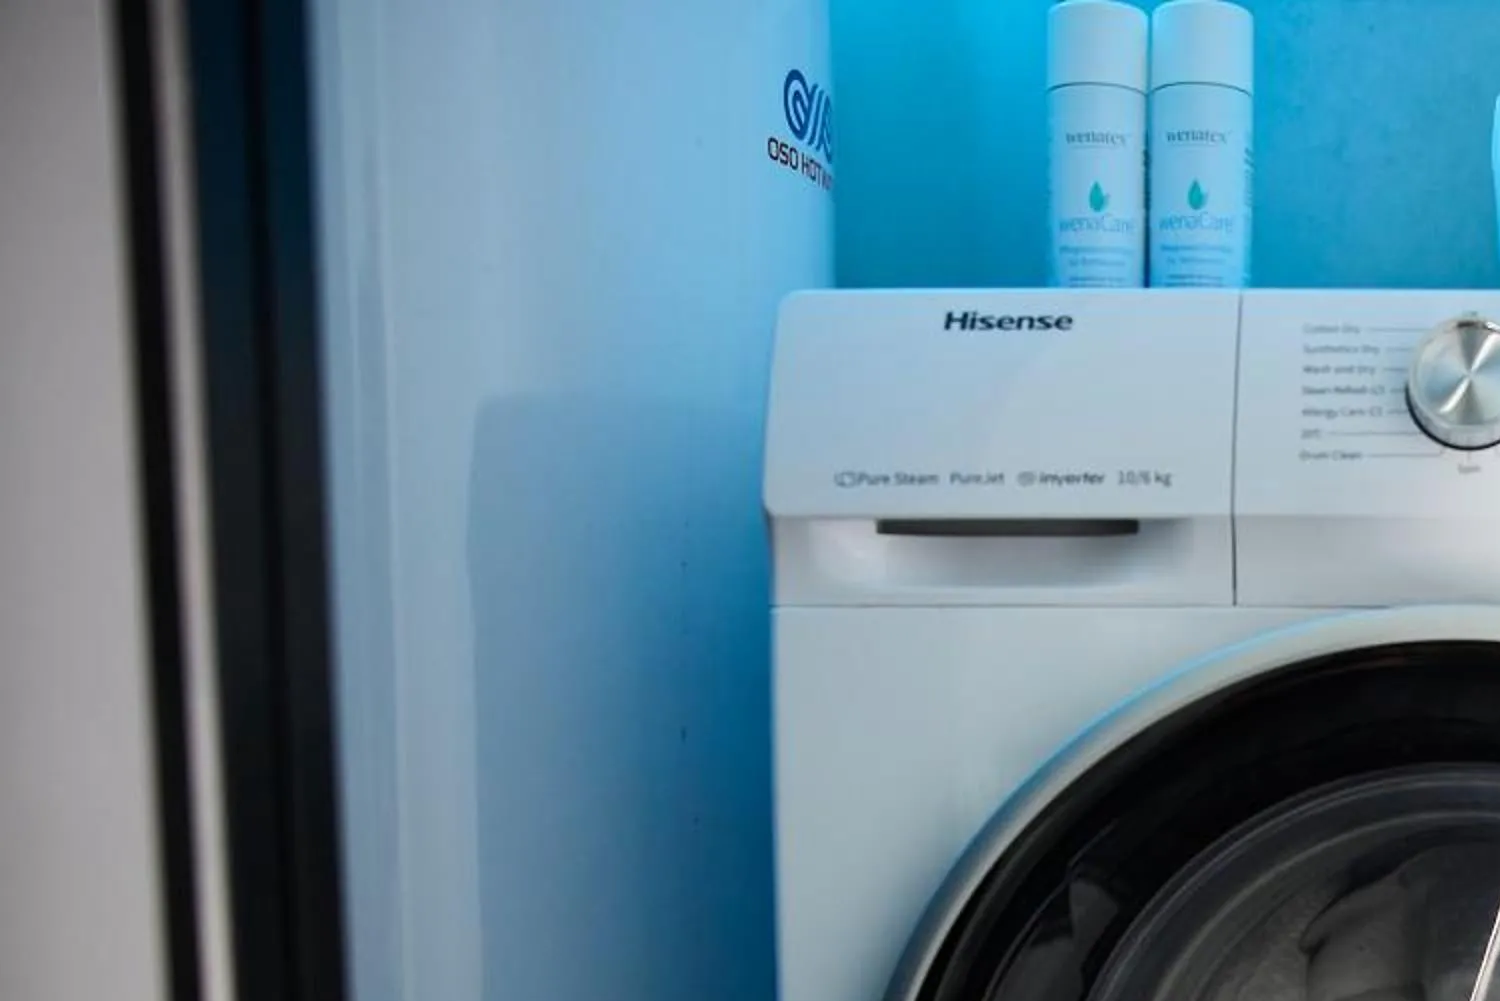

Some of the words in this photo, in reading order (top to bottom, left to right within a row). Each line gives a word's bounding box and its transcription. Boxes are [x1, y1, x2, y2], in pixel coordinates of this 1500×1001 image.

[767, 136, 799, 171] OSO
[943, 311, 1073, 331] Hisense
[894, 471, 940, 486] Steam
